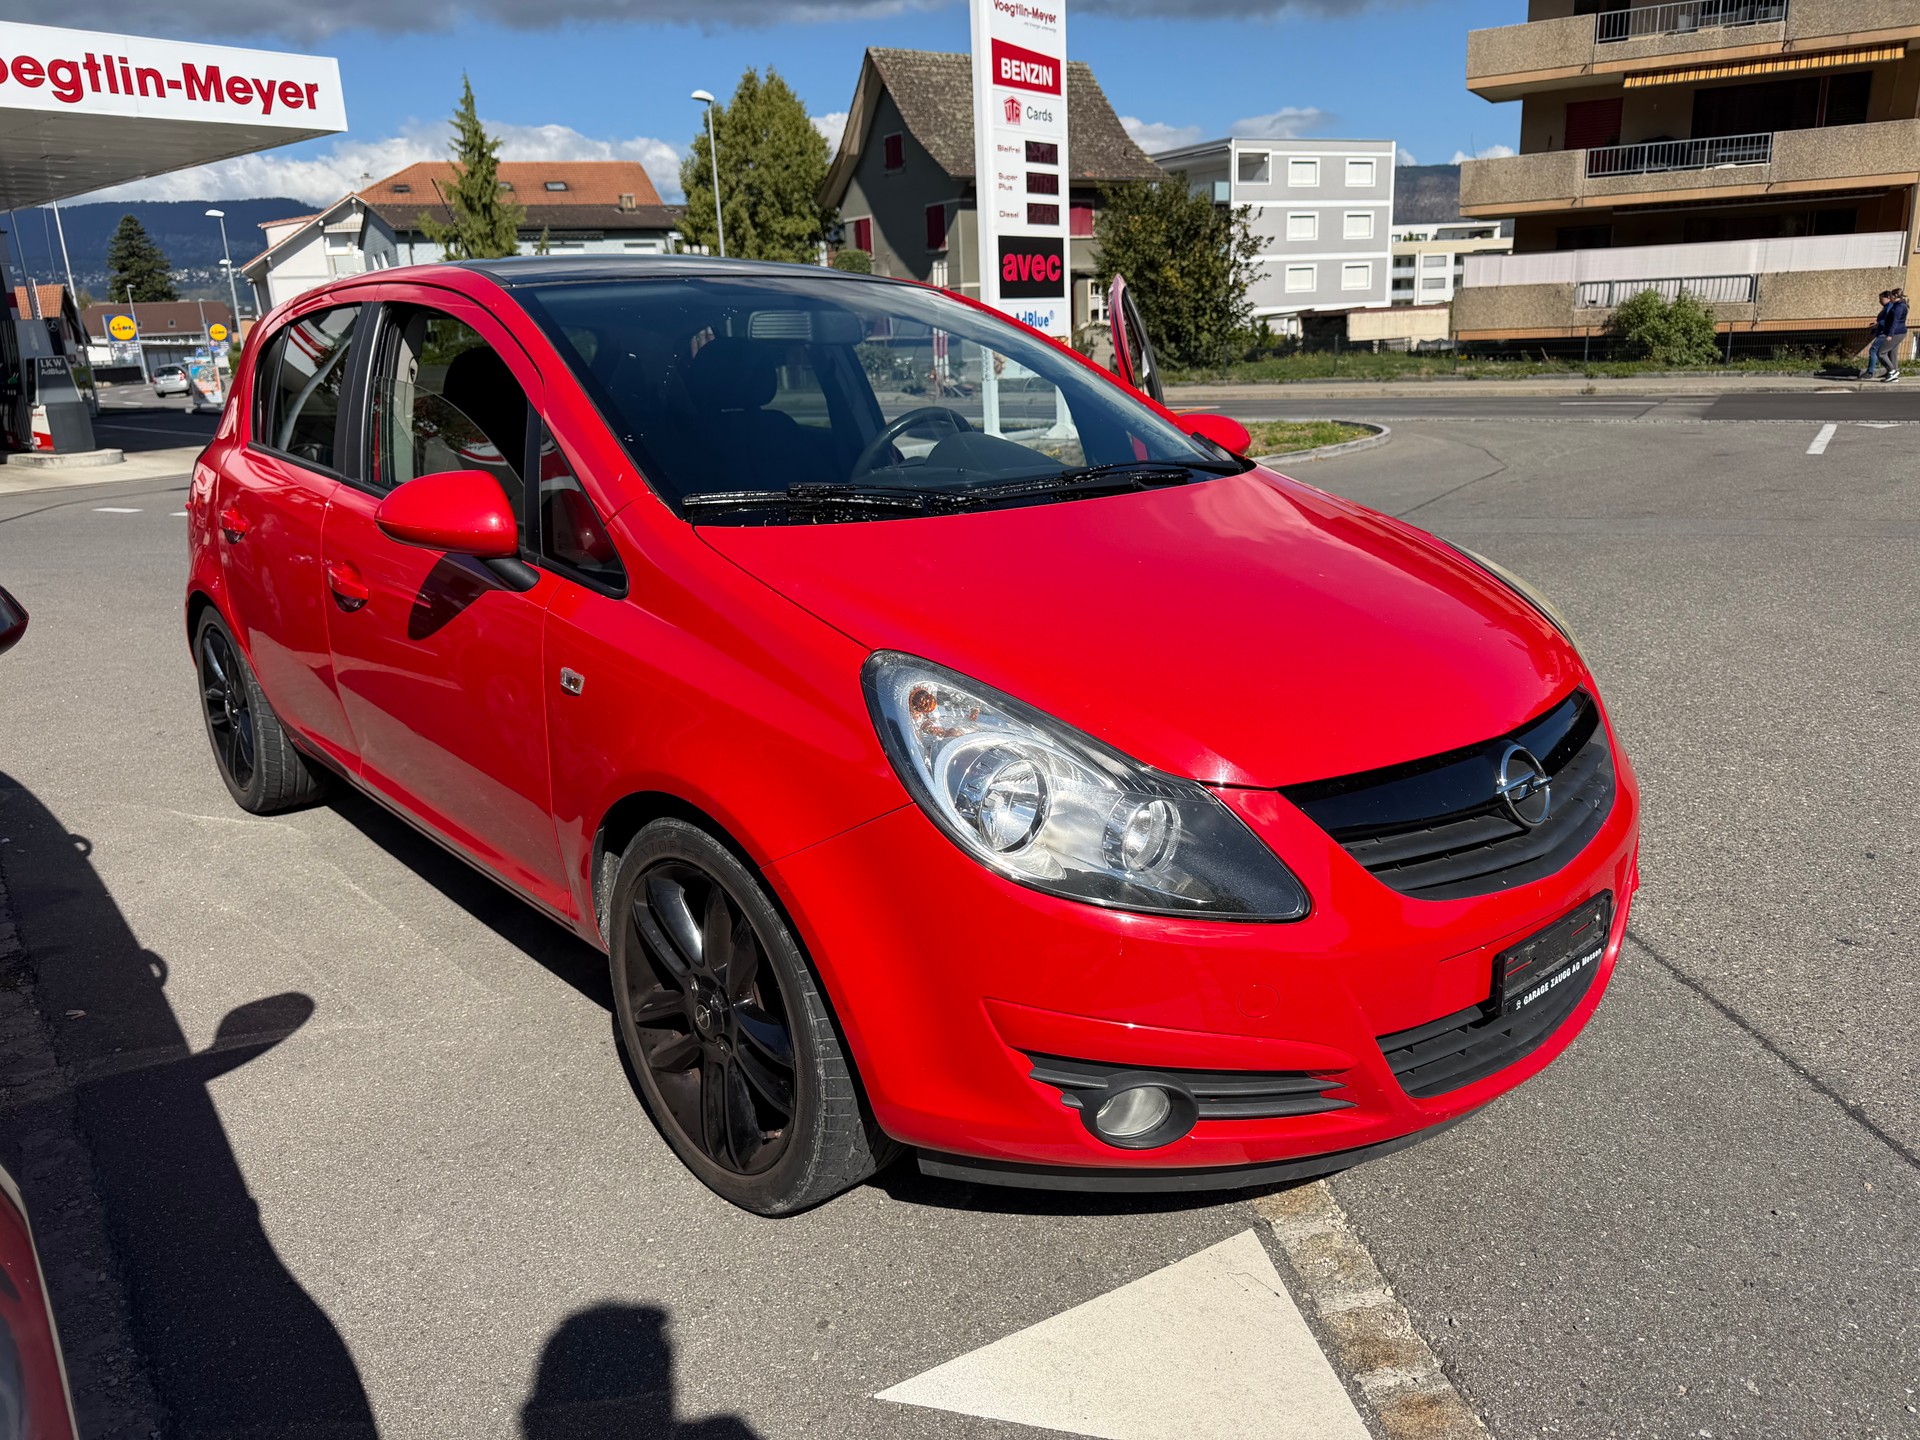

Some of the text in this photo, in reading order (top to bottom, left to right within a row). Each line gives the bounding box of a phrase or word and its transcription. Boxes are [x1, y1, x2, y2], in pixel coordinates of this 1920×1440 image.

[1001, 57, 1053, 87] BENZIN
[0, 53, 319, 115] egtlin-Meyer
[1026, 106, 1053, 122] Cards
[997, 145, 1020, 153] Bleifrei
[998, 173, 1018, 181] Super
[998, 183, 1013, 191] Plus
[1003, 253, 1061, 282] avec
[40, 359, 62, 367] LKW
[1523, 982, 1549, 1005] GARAGE
[1572, 961, 1580, 973] AG
